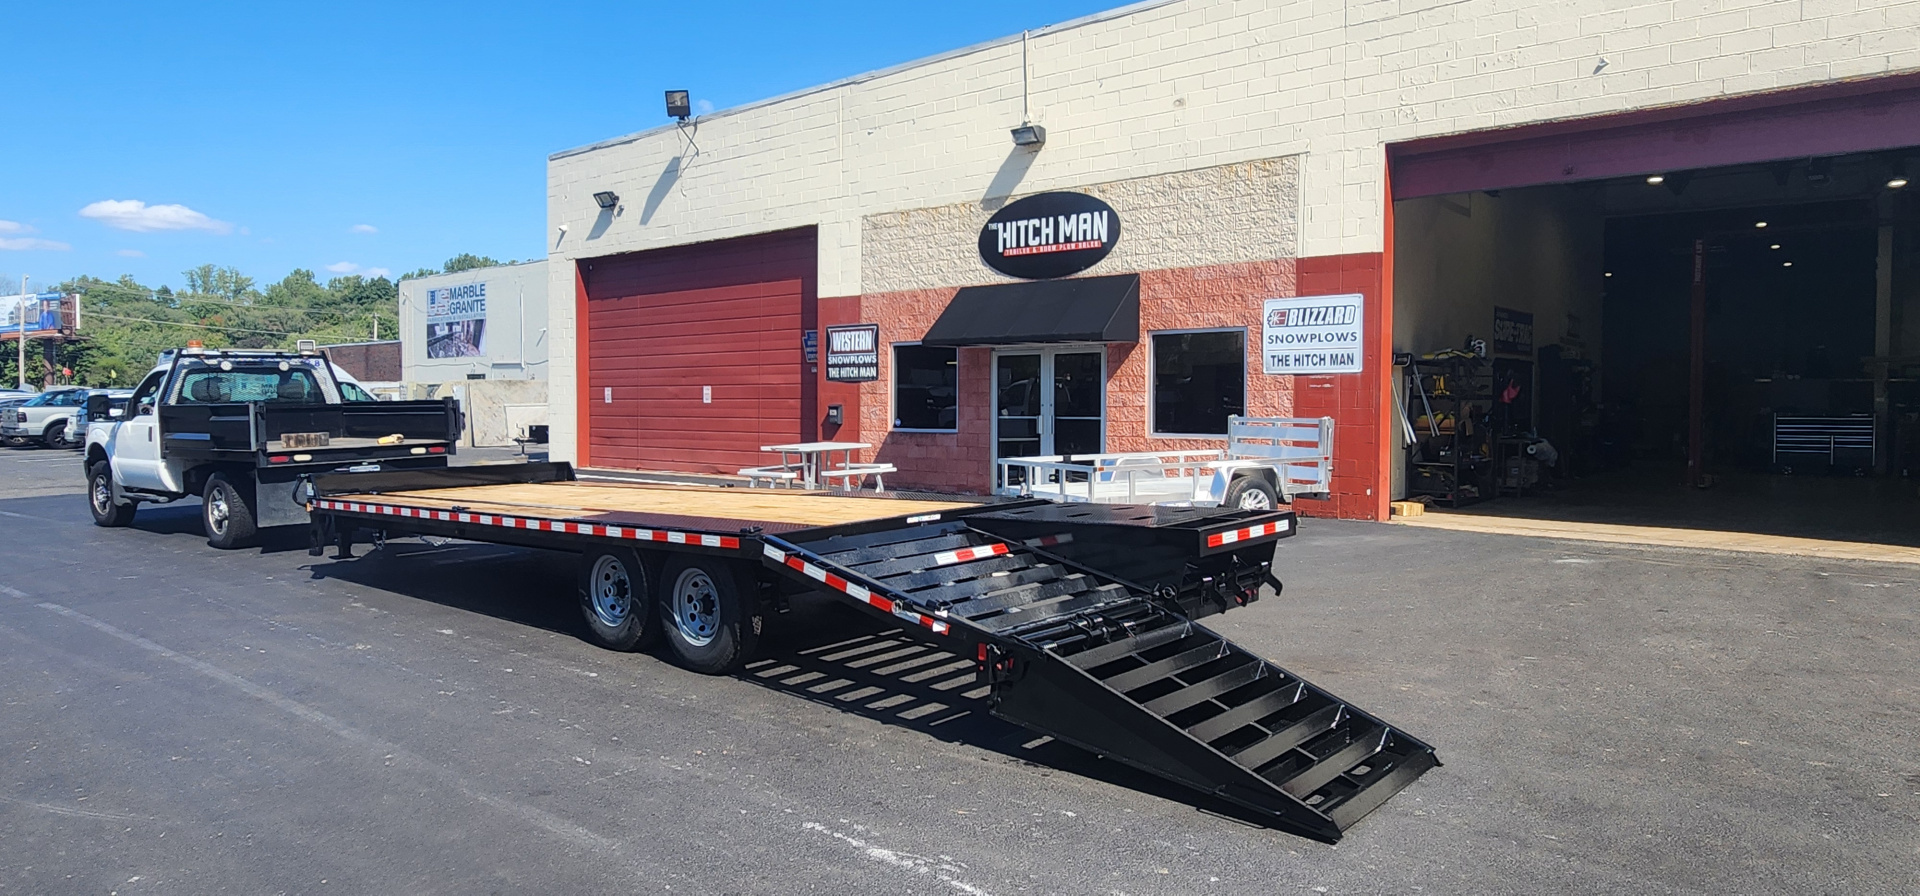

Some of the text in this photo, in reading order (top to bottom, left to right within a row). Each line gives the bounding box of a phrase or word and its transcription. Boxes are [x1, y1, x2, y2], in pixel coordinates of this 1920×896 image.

[988, 210, 1108, 253] THE HITCH MAN
[1059, 243, 1076, 251] PLOW
[450, 284, 486, 300] MARBLE
[449, 299, 486, 315] GRANITE
[1287, 306, 1356, 327] BLIZZARD
[832, 330, 872, 351] WESTERN
[1267, 331, 1358, 344] SNOWPLOWS
[828, 355, 877, 365] SNOWPLOWS
[1270, 352, 1354, 367] THE HITCH MAN
[828, 367, 840, 378] THE
[841, 366, 859, 378] HITCH
[860, 366, 877, 378] MAN
